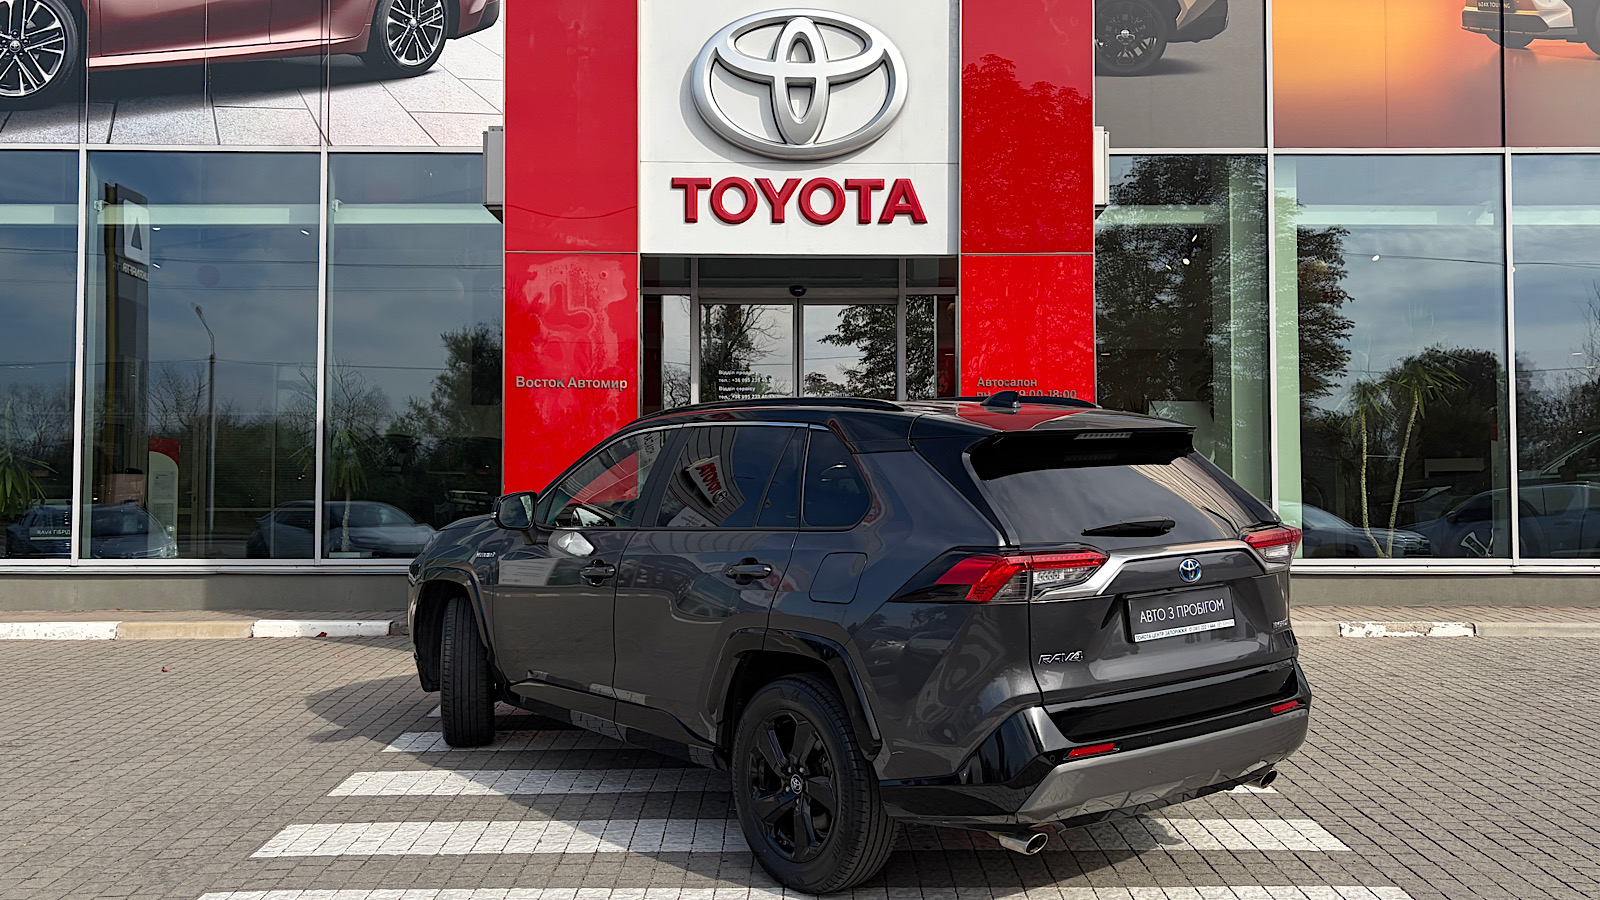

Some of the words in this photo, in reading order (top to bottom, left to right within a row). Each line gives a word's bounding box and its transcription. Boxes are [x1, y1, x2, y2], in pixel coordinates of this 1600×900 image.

[671, 177, 928, 225] TOYOTA
[515, 376, 565, 388] Восток
[567, 377, 628, 392] Автомир
[977, 377, 1038, 387] Автосалон
[1140, 608, 1166, 623] АВТО
[1168, 607, 1175, 620] З
[1176, 598, 1225, 618] ПРОБІГОМ
[1037, 650, 1084, 665] RAV4
